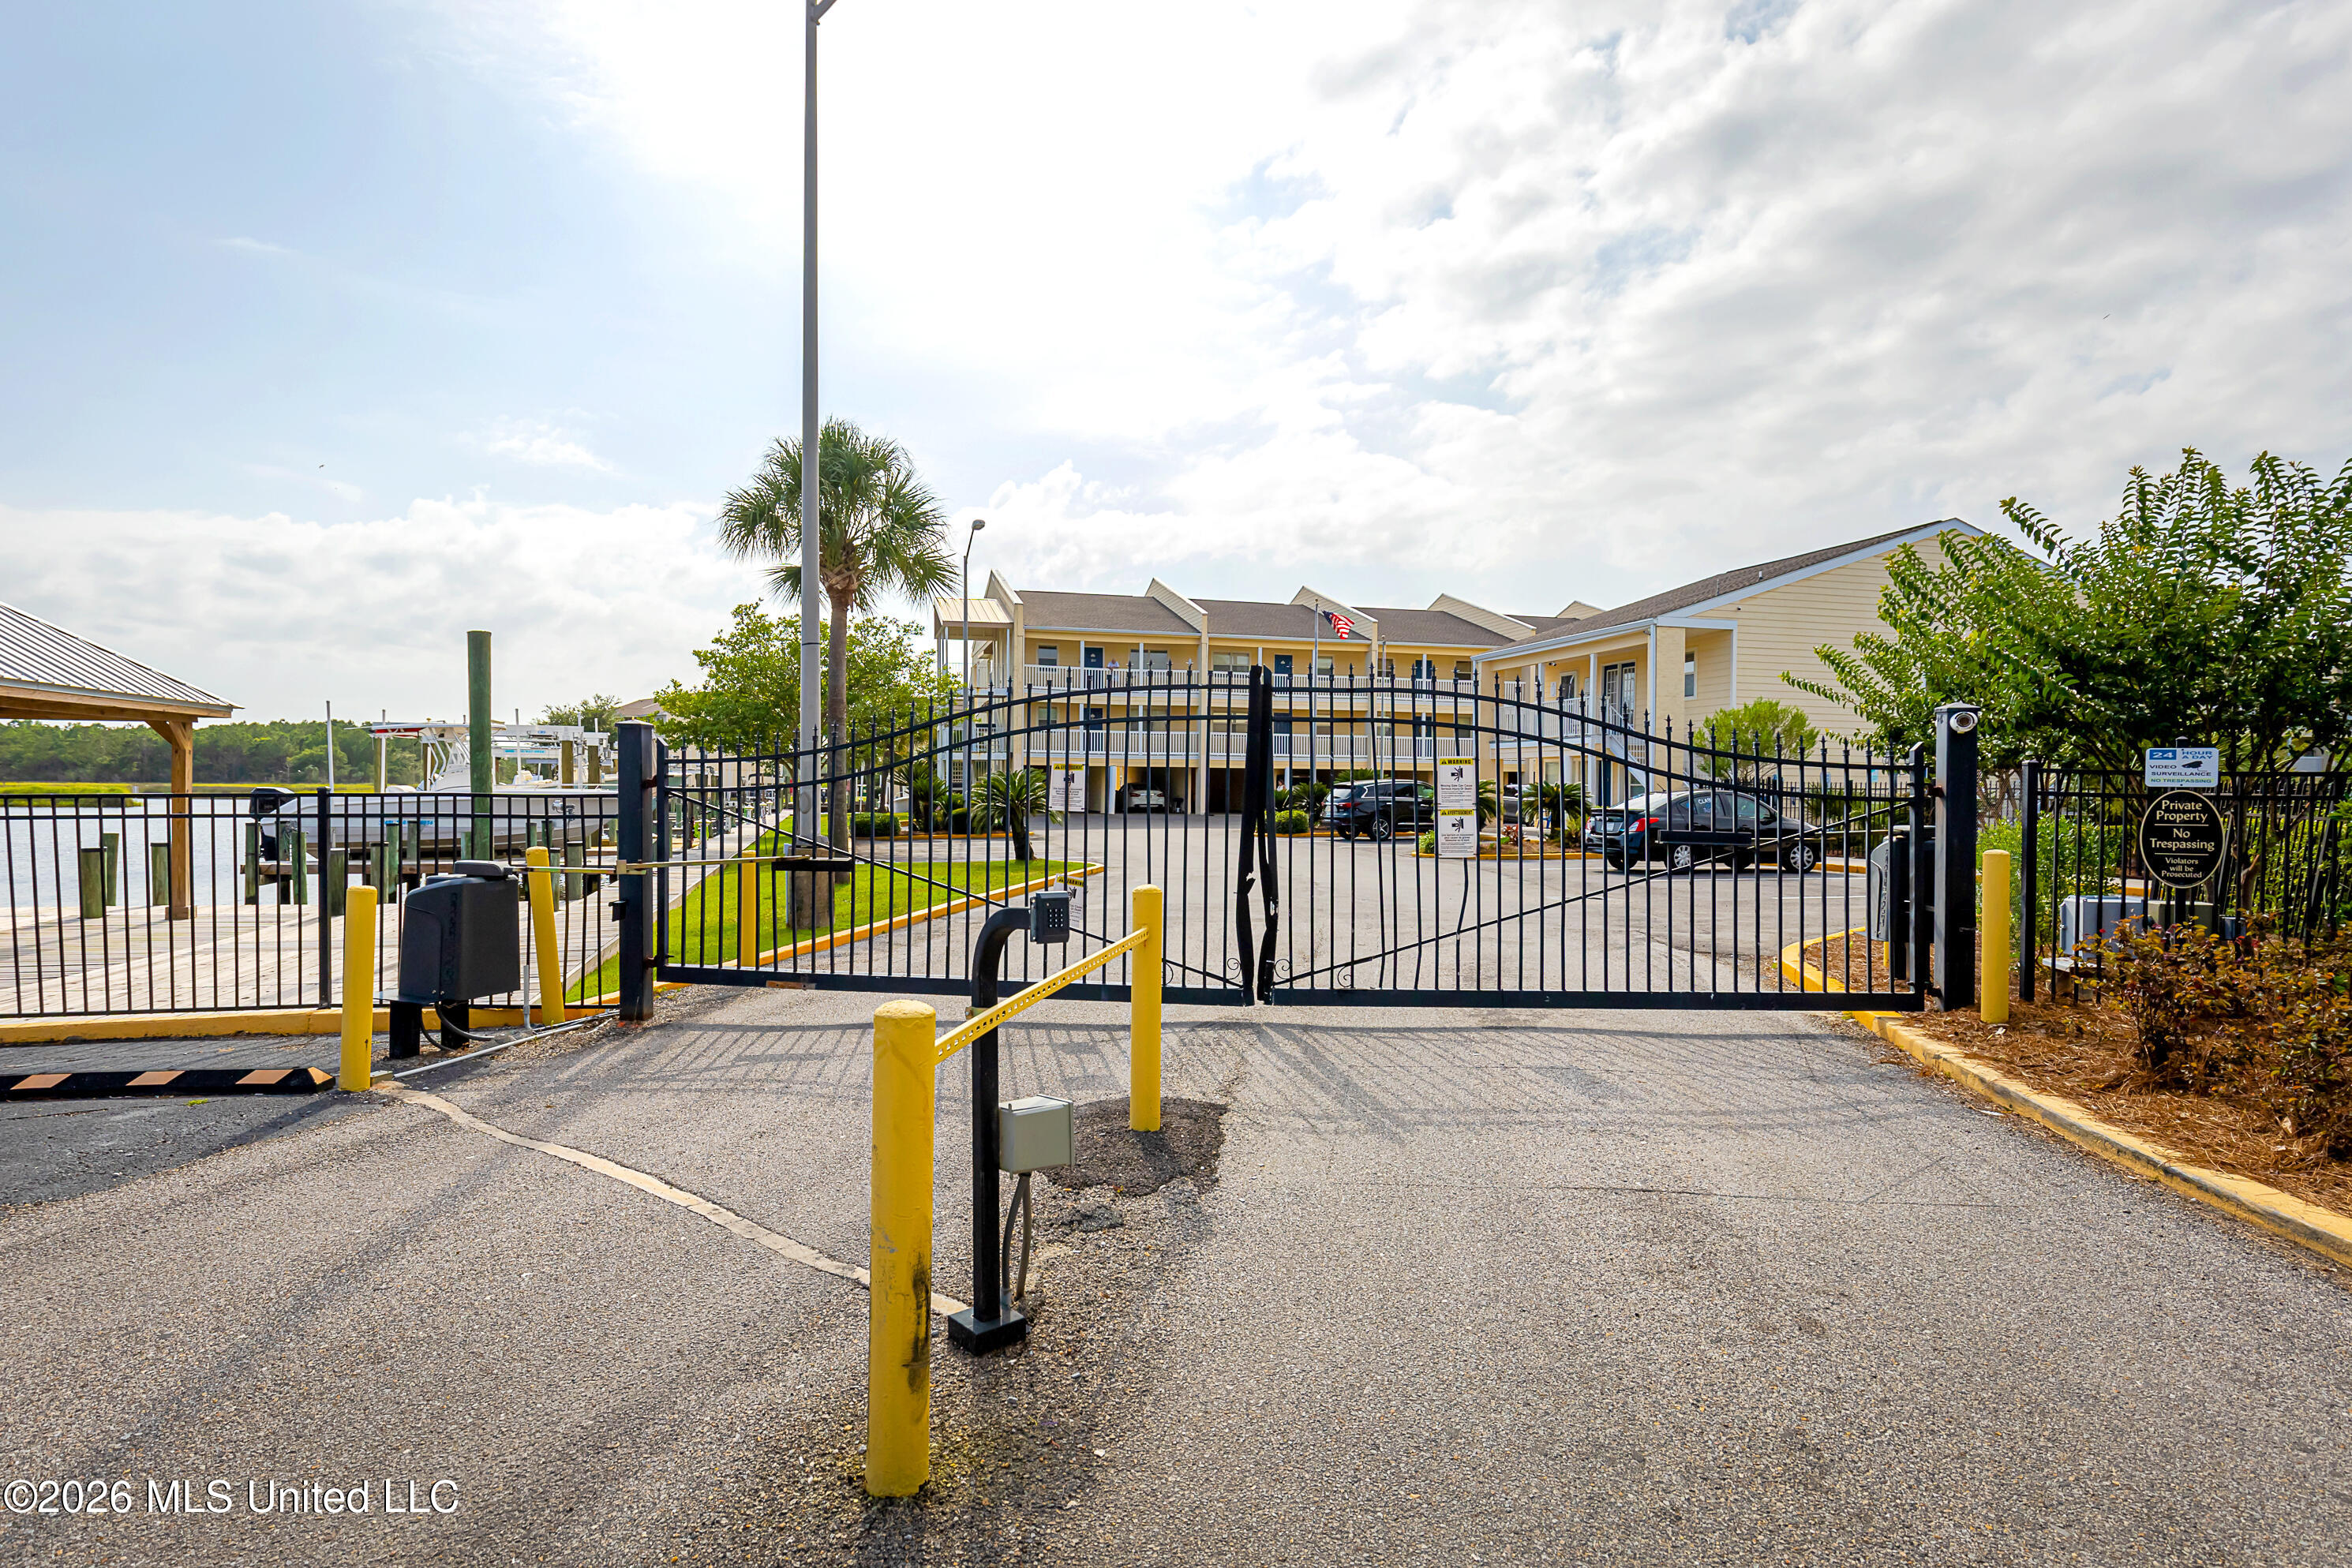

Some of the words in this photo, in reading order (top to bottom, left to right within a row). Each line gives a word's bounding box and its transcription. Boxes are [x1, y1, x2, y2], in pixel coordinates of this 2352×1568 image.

[2161, 799, 2202, 810] Private
[2156, 810, 2208, 822] Property
[2173, 828, 2190, 838] No
[2149, 838, 2215, 851] Trespassing
